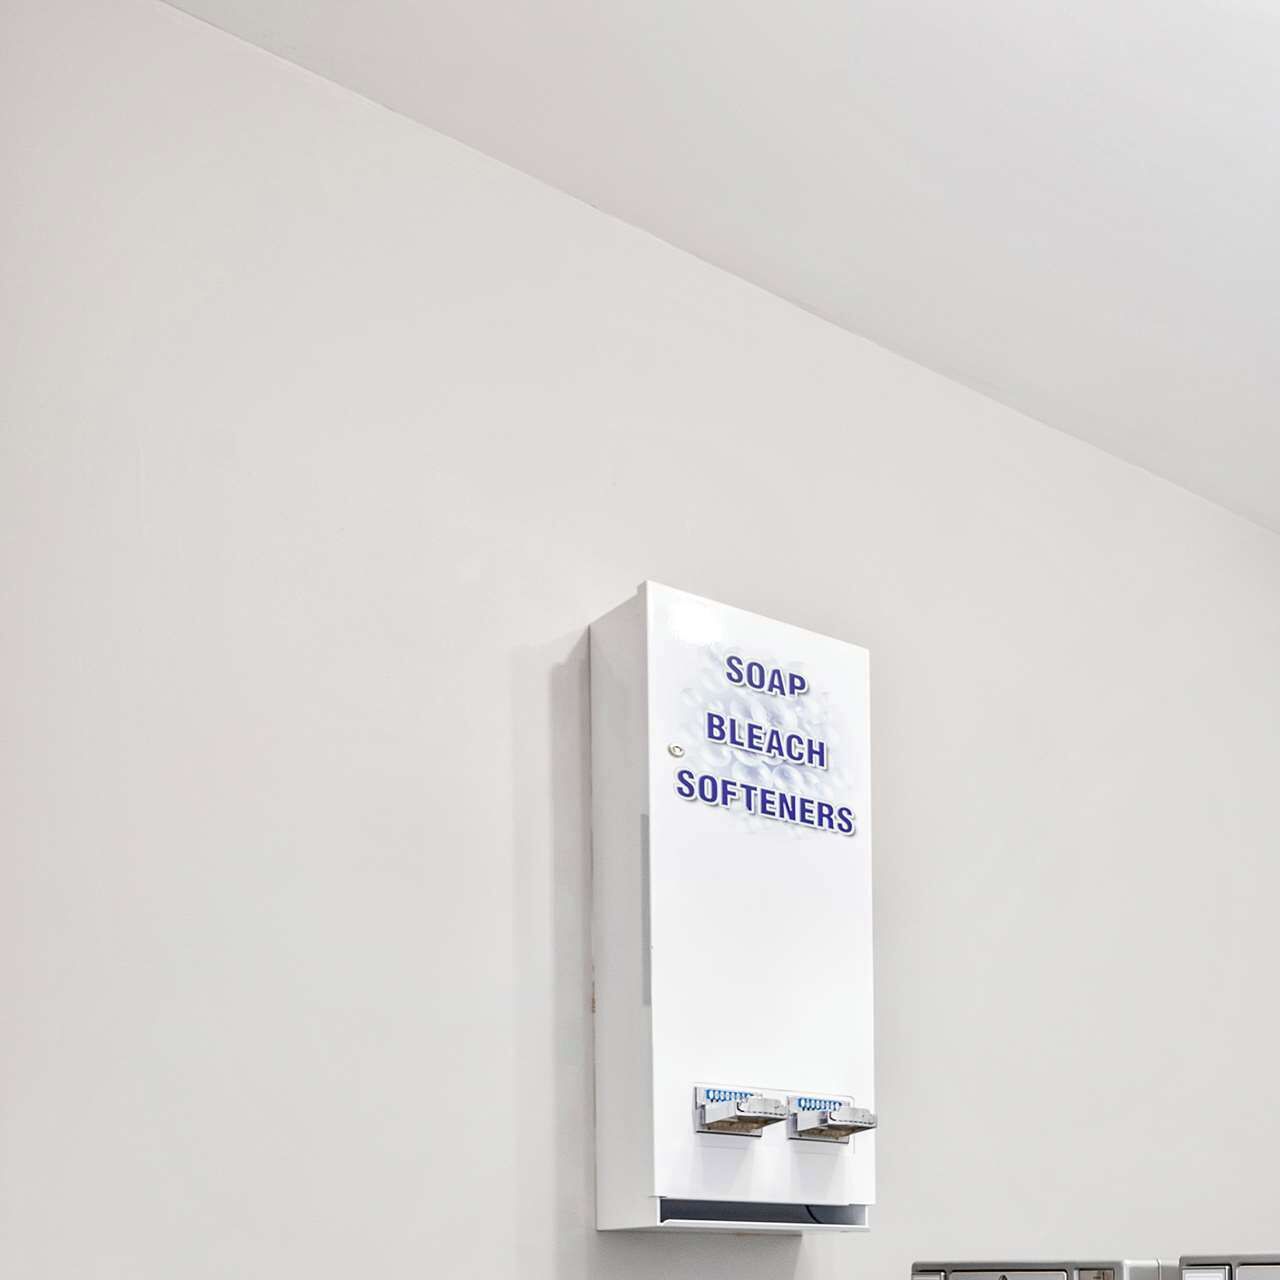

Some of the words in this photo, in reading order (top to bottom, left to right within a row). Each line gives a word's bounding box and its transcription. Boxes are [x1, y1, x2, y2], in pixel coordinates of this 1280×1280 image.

[725, 655, 807, 697] SOAP
[706, 711, 826, 768] BLEACH
[676, 769, 854, 834] SOFTENERS
